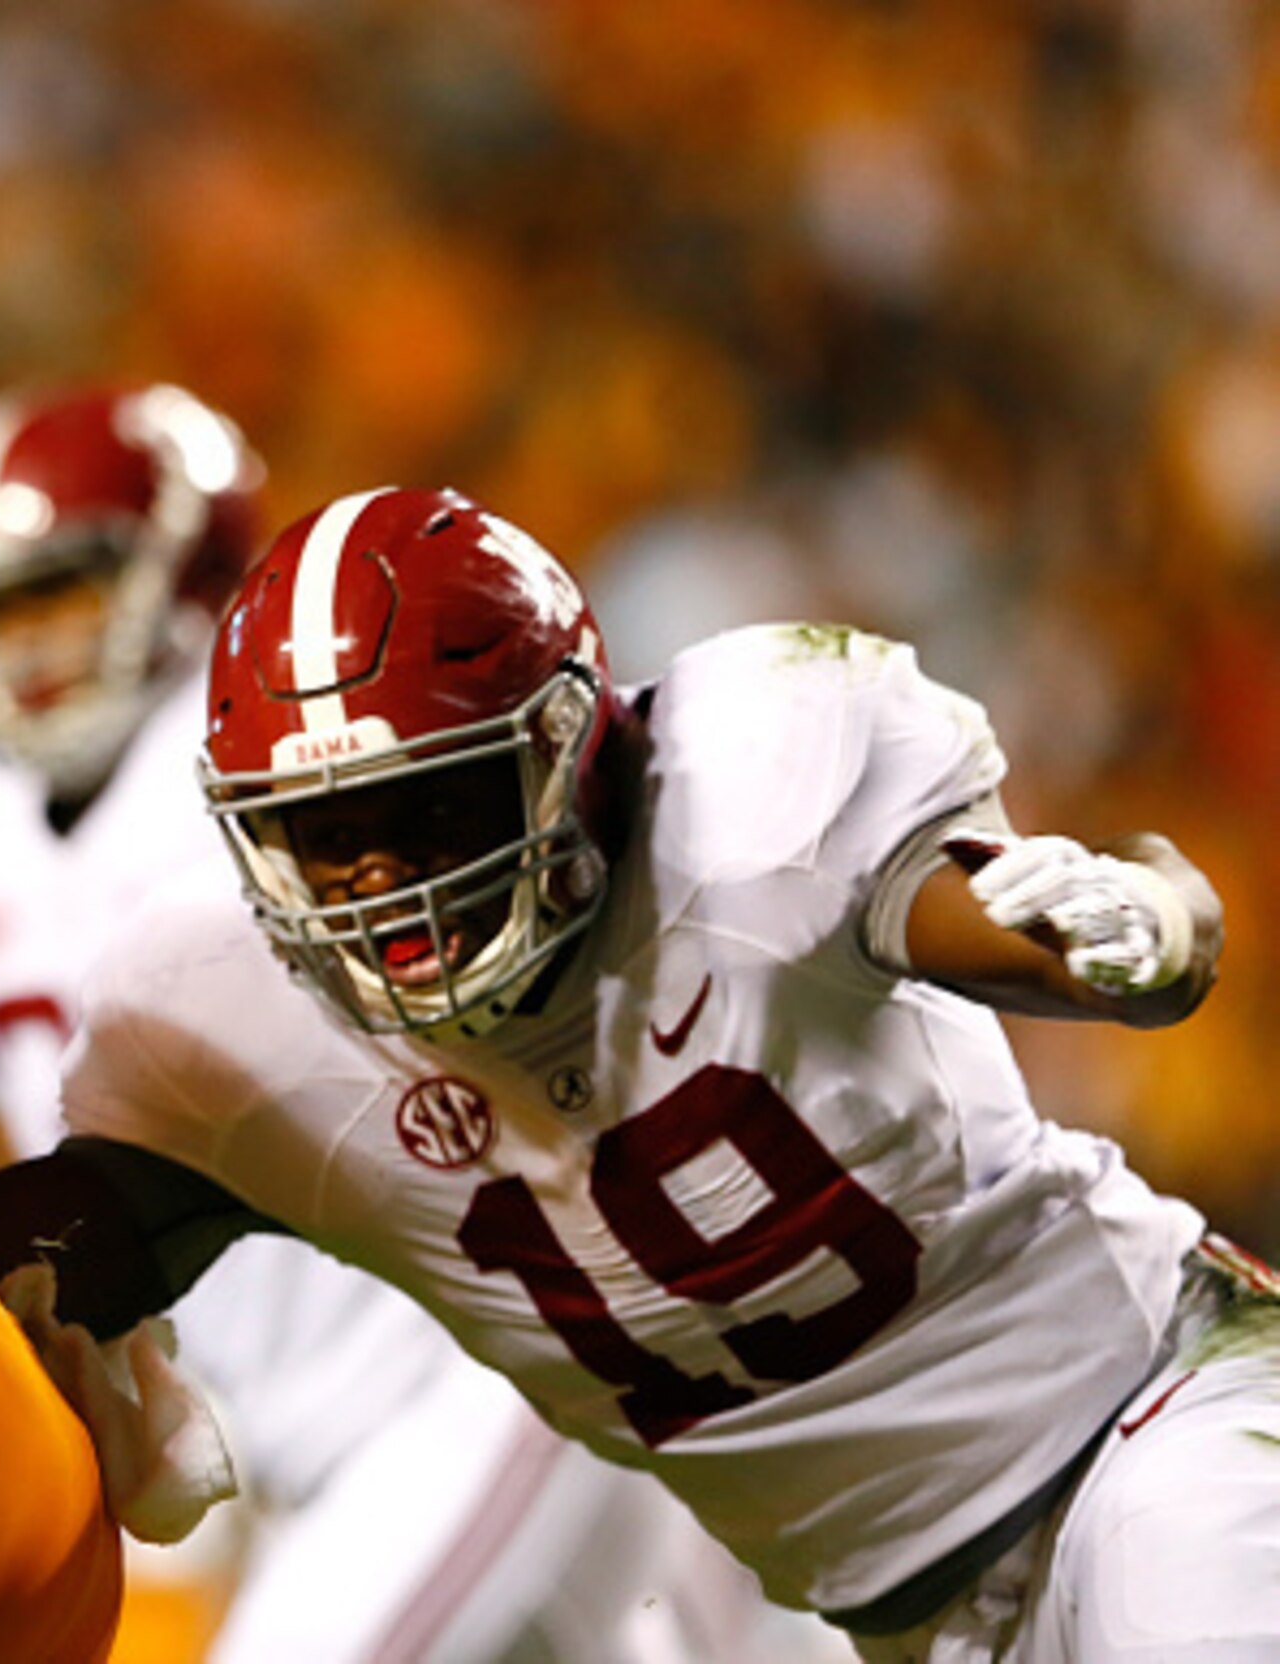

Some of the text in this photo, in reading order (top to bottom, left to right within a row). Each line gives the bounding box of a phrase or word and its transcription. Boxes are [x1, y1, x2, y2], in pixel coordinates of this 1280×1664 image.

[295, 734, 363, 764] BAMA
[399, 1079, 492, 1167] SEC
[455, 1062, 923, 1450] 19
